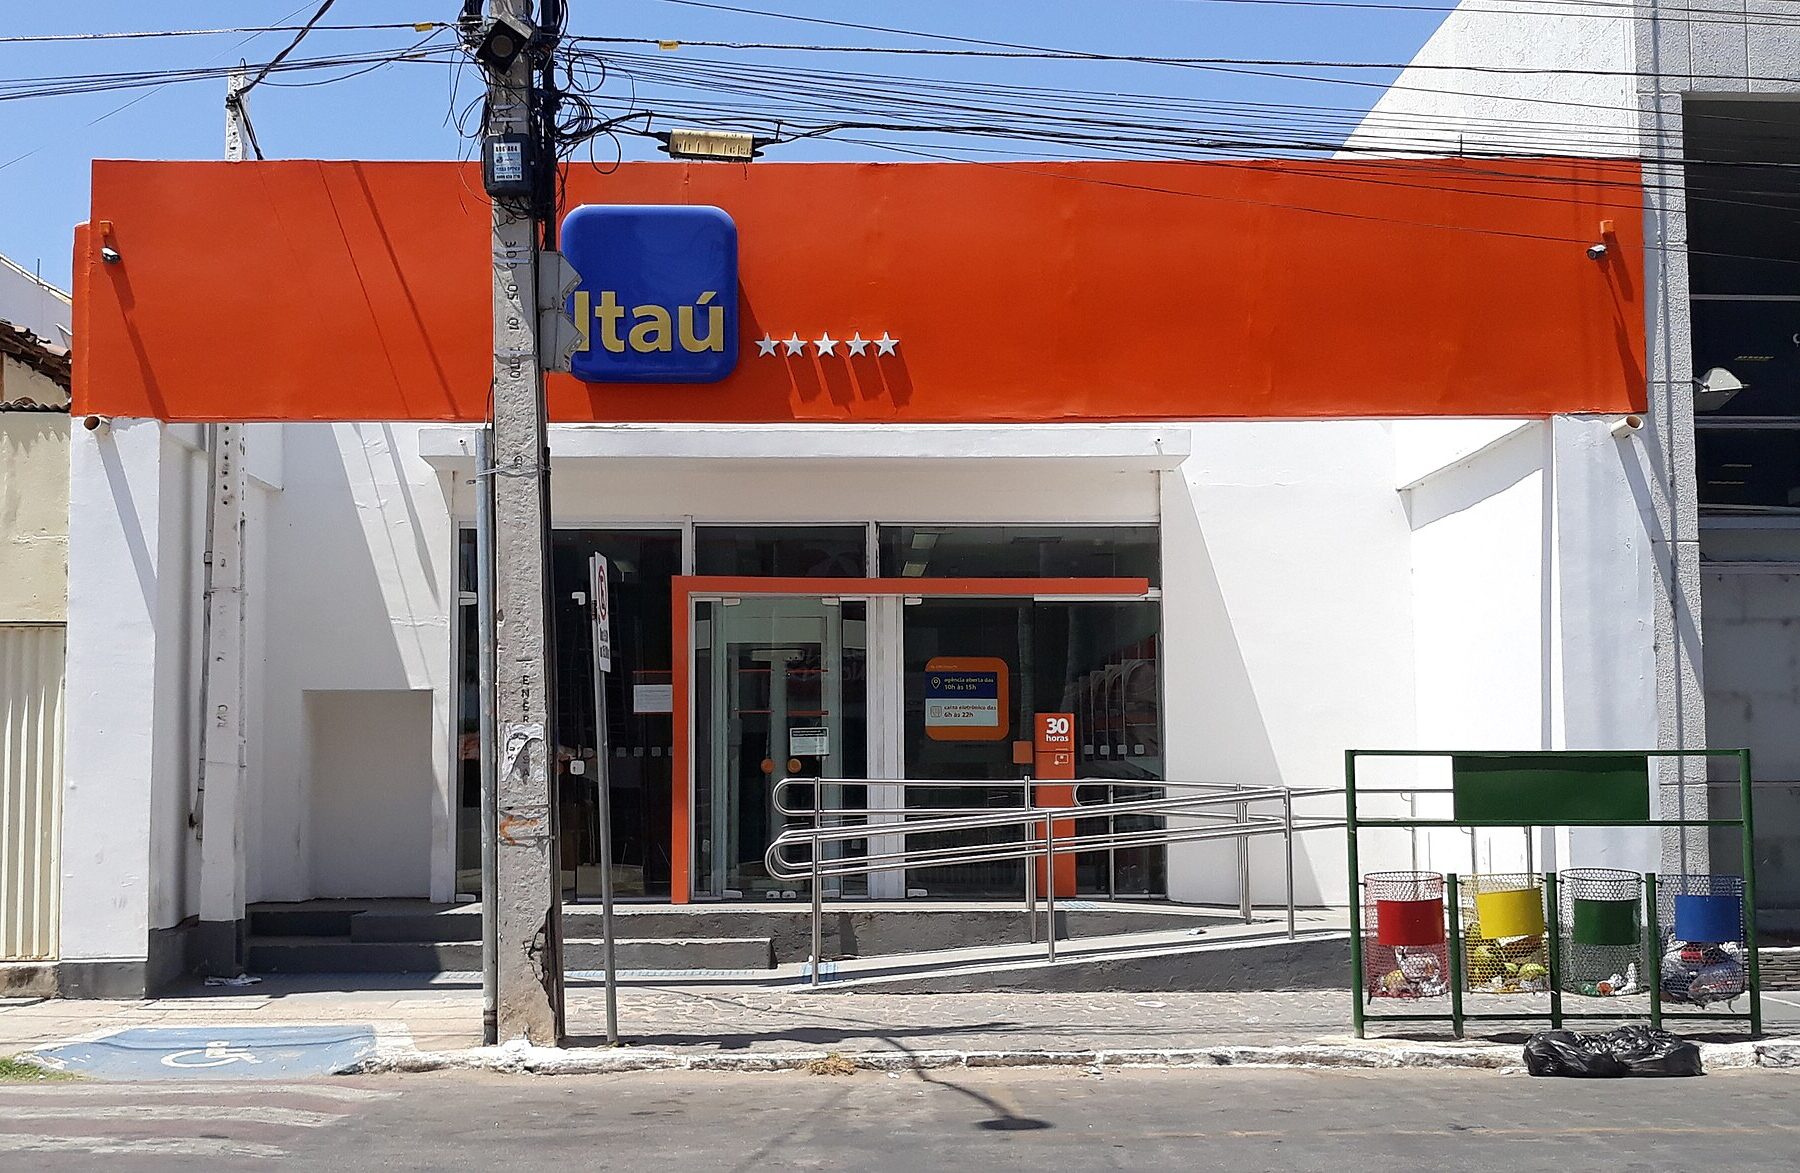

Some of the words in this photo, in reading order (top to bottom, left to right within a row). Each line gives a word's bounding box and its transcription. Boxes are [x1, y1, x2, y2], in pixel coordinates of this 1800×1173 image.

[574, 291, 724, 353] Itaú
[1046, 717, 1069, 734] 30
[1046, 734, 1069, 742] horas
